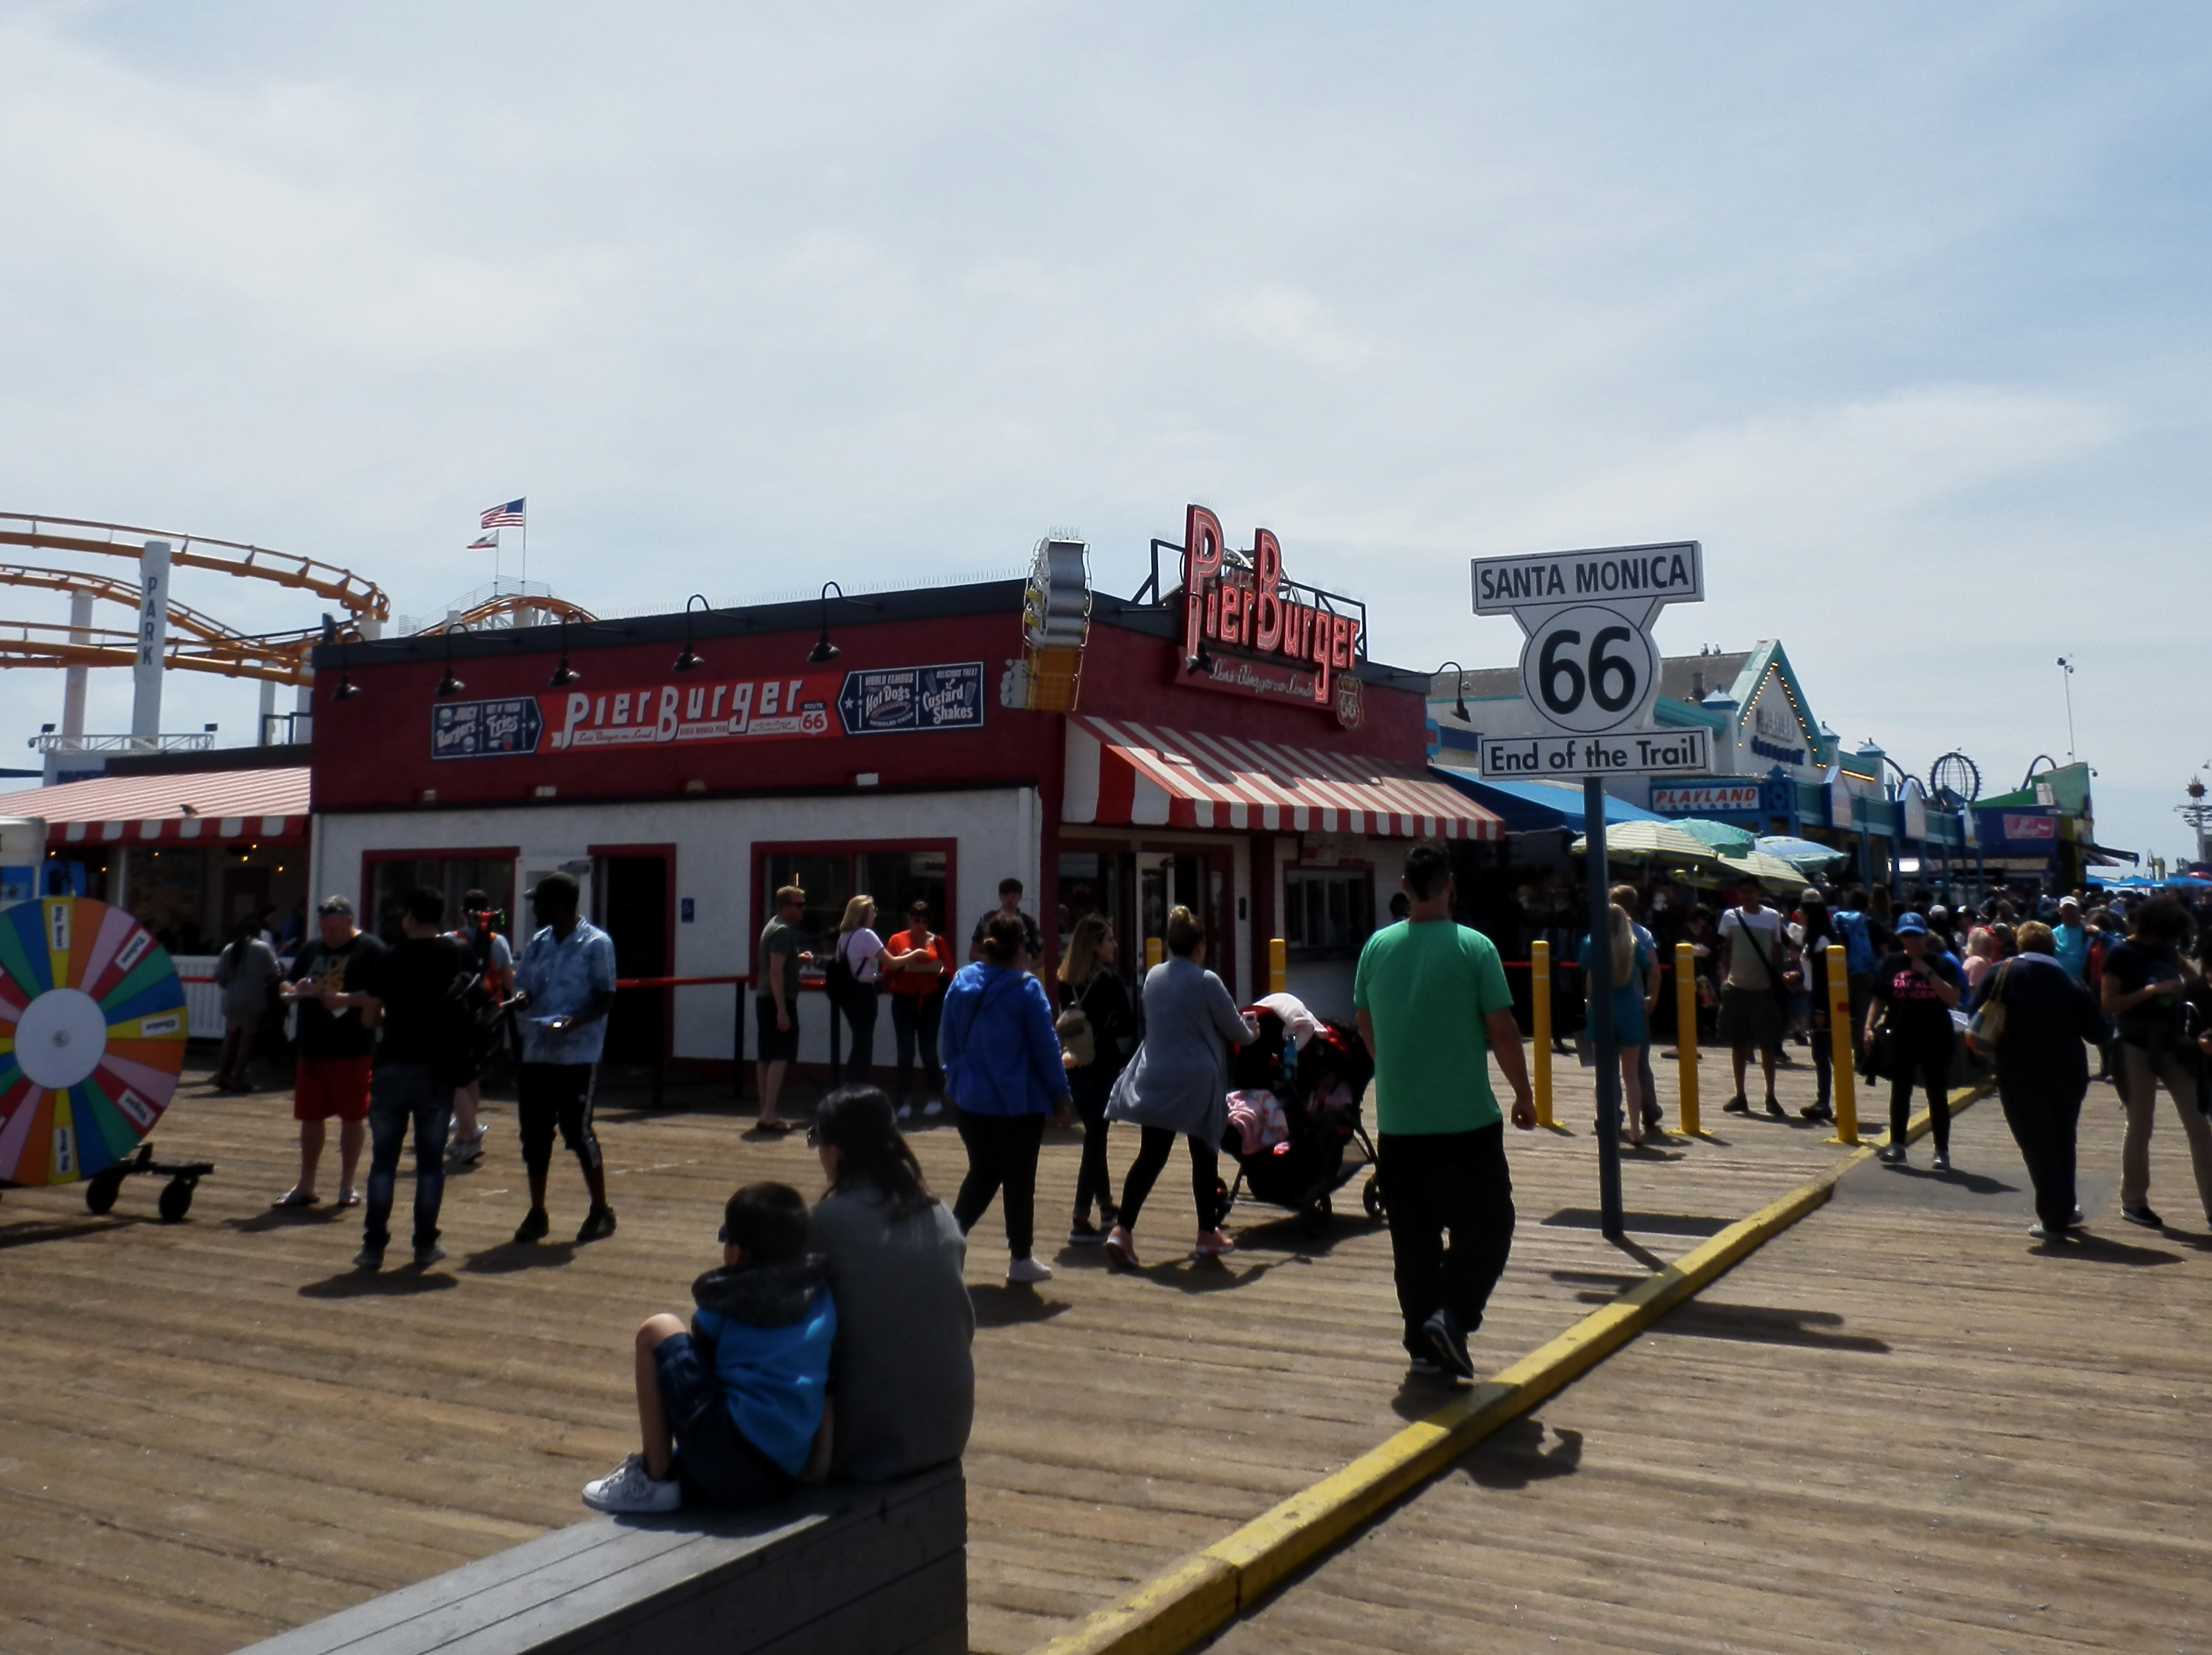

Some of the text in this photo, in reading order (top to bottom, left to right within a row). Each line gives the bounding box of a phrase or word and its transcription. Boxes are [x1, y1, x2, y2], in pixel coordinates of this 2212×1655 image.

[1480, 554, 1688, 600] SANTA MONICA
[142, 577, 157, 665] PARK
[865, 673, 914, 686] WORLD FAMOUS
[1539, 626, 1636, 715] 66
[866, 685, 911, 718] Hot Dogs
[922, 684, 963, 712] Custard
[803, 714, 824, 730] 66
[932, 705, 973, 725] Shakes
[1491, 736, 1696, 771] End of the Trail
[1655, 788, 1757, 804] PLAYLAND
